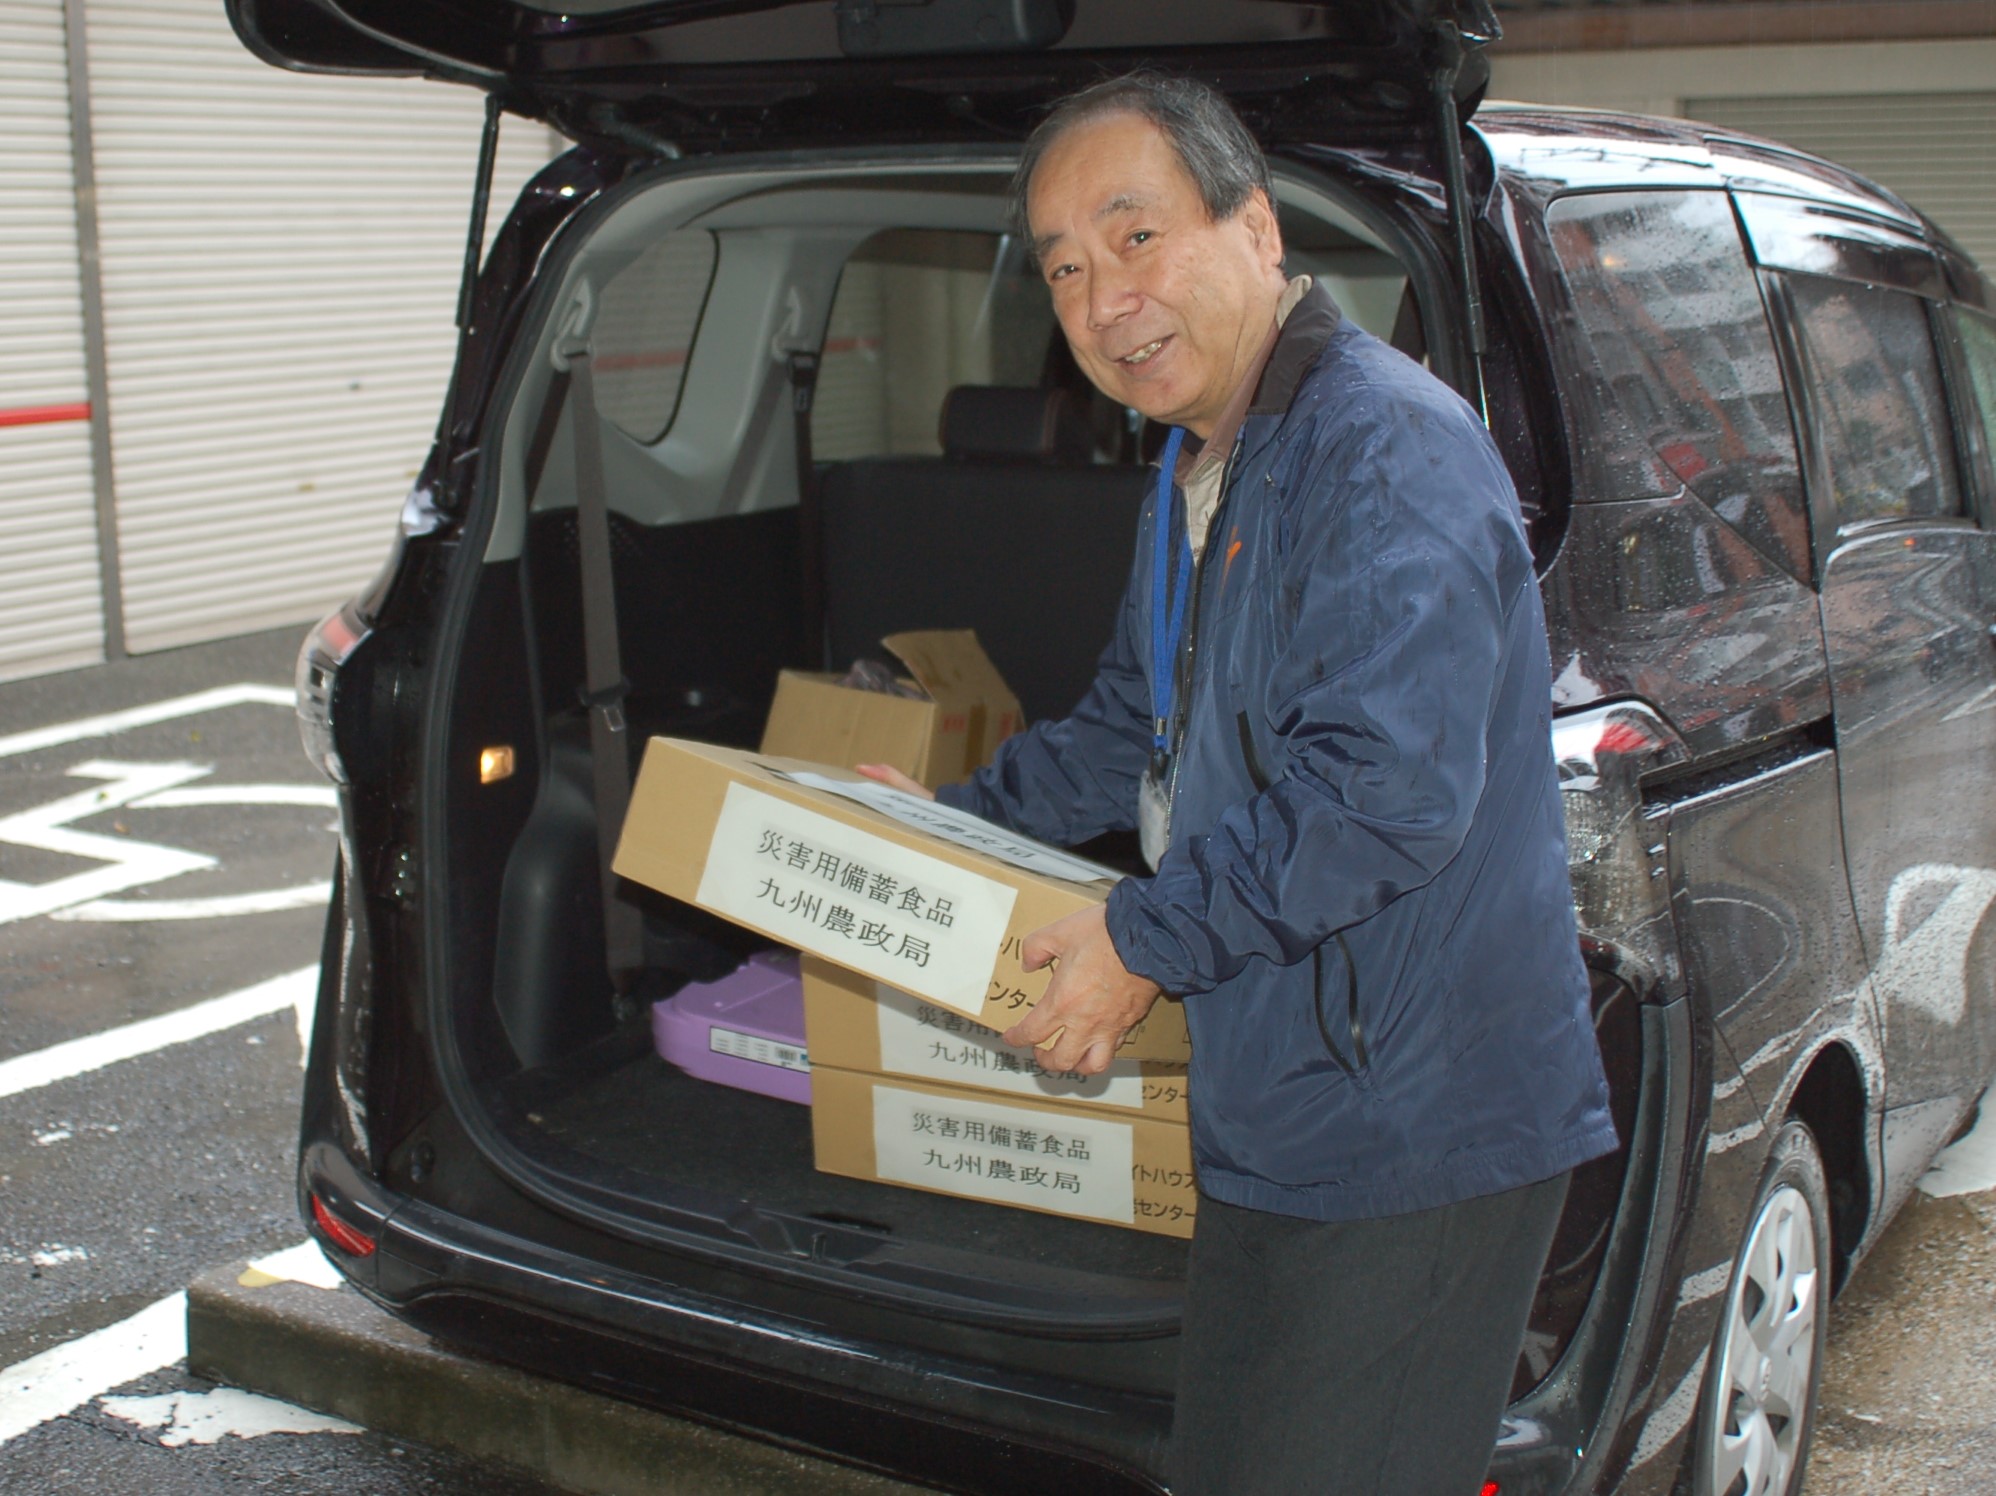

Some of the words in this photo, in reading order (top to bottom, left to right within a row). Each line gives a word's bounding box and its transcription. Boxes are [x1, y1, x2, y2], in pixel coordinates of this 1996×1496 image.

[758, 828, 956, 928] 災害用備蓄食品
[756, 876, 933, 968] 九州農政局
[912, 1111, 1091, 1161] 災害用備蓄食品
[923, 1149, 1082, 1194] 九州農政局
